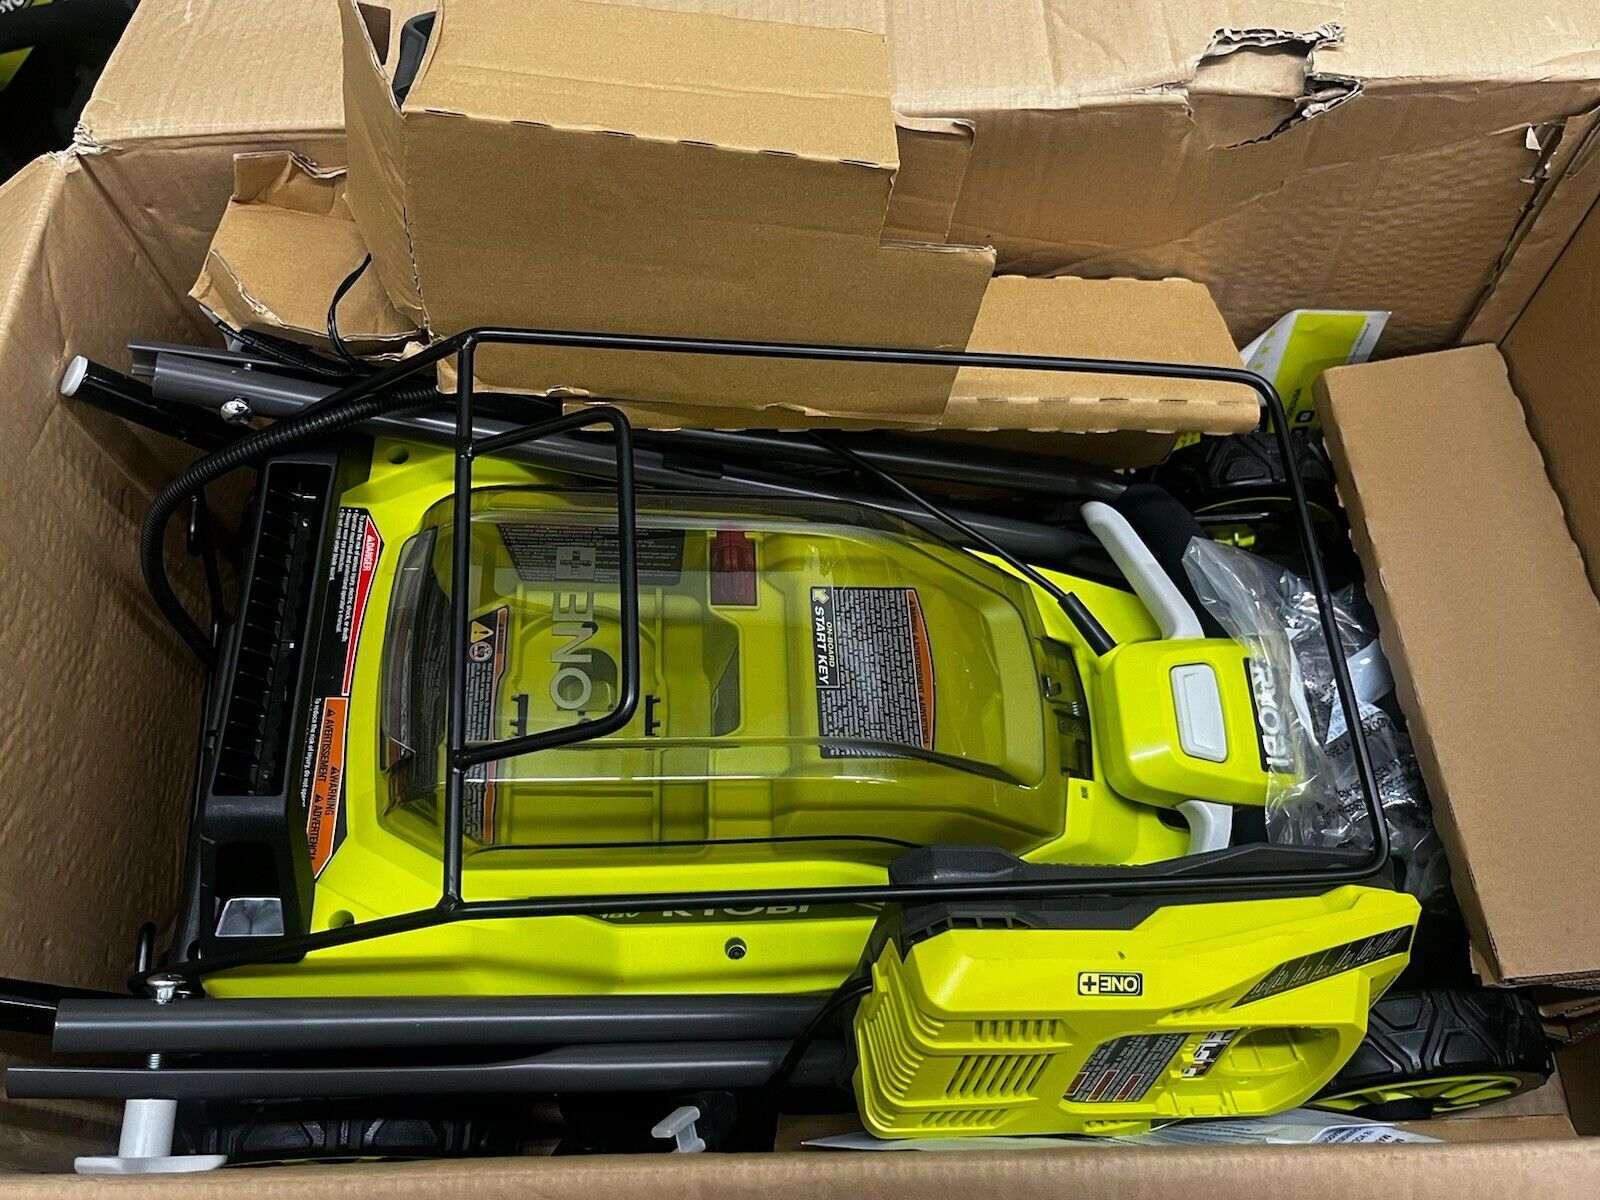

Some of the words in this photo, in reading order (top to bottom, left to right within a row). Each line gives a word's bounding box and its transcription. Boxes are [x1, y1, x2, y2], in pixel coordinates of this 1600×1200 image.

[363, 543, 375, 571] DANGER
[815, 606, 827, 652] START
[826, 621, 836, 668] ON-BOARD
[818, 654, 830, 685] KEY
[310, 724, 318, 733] the
[311, 705, 320, 723] reduce
[1252, 664, 1291, 768] RYOBI
[318, 719, 335, 782] AVERTISSEMENT
[325, 775, 339, 816] WARNING
